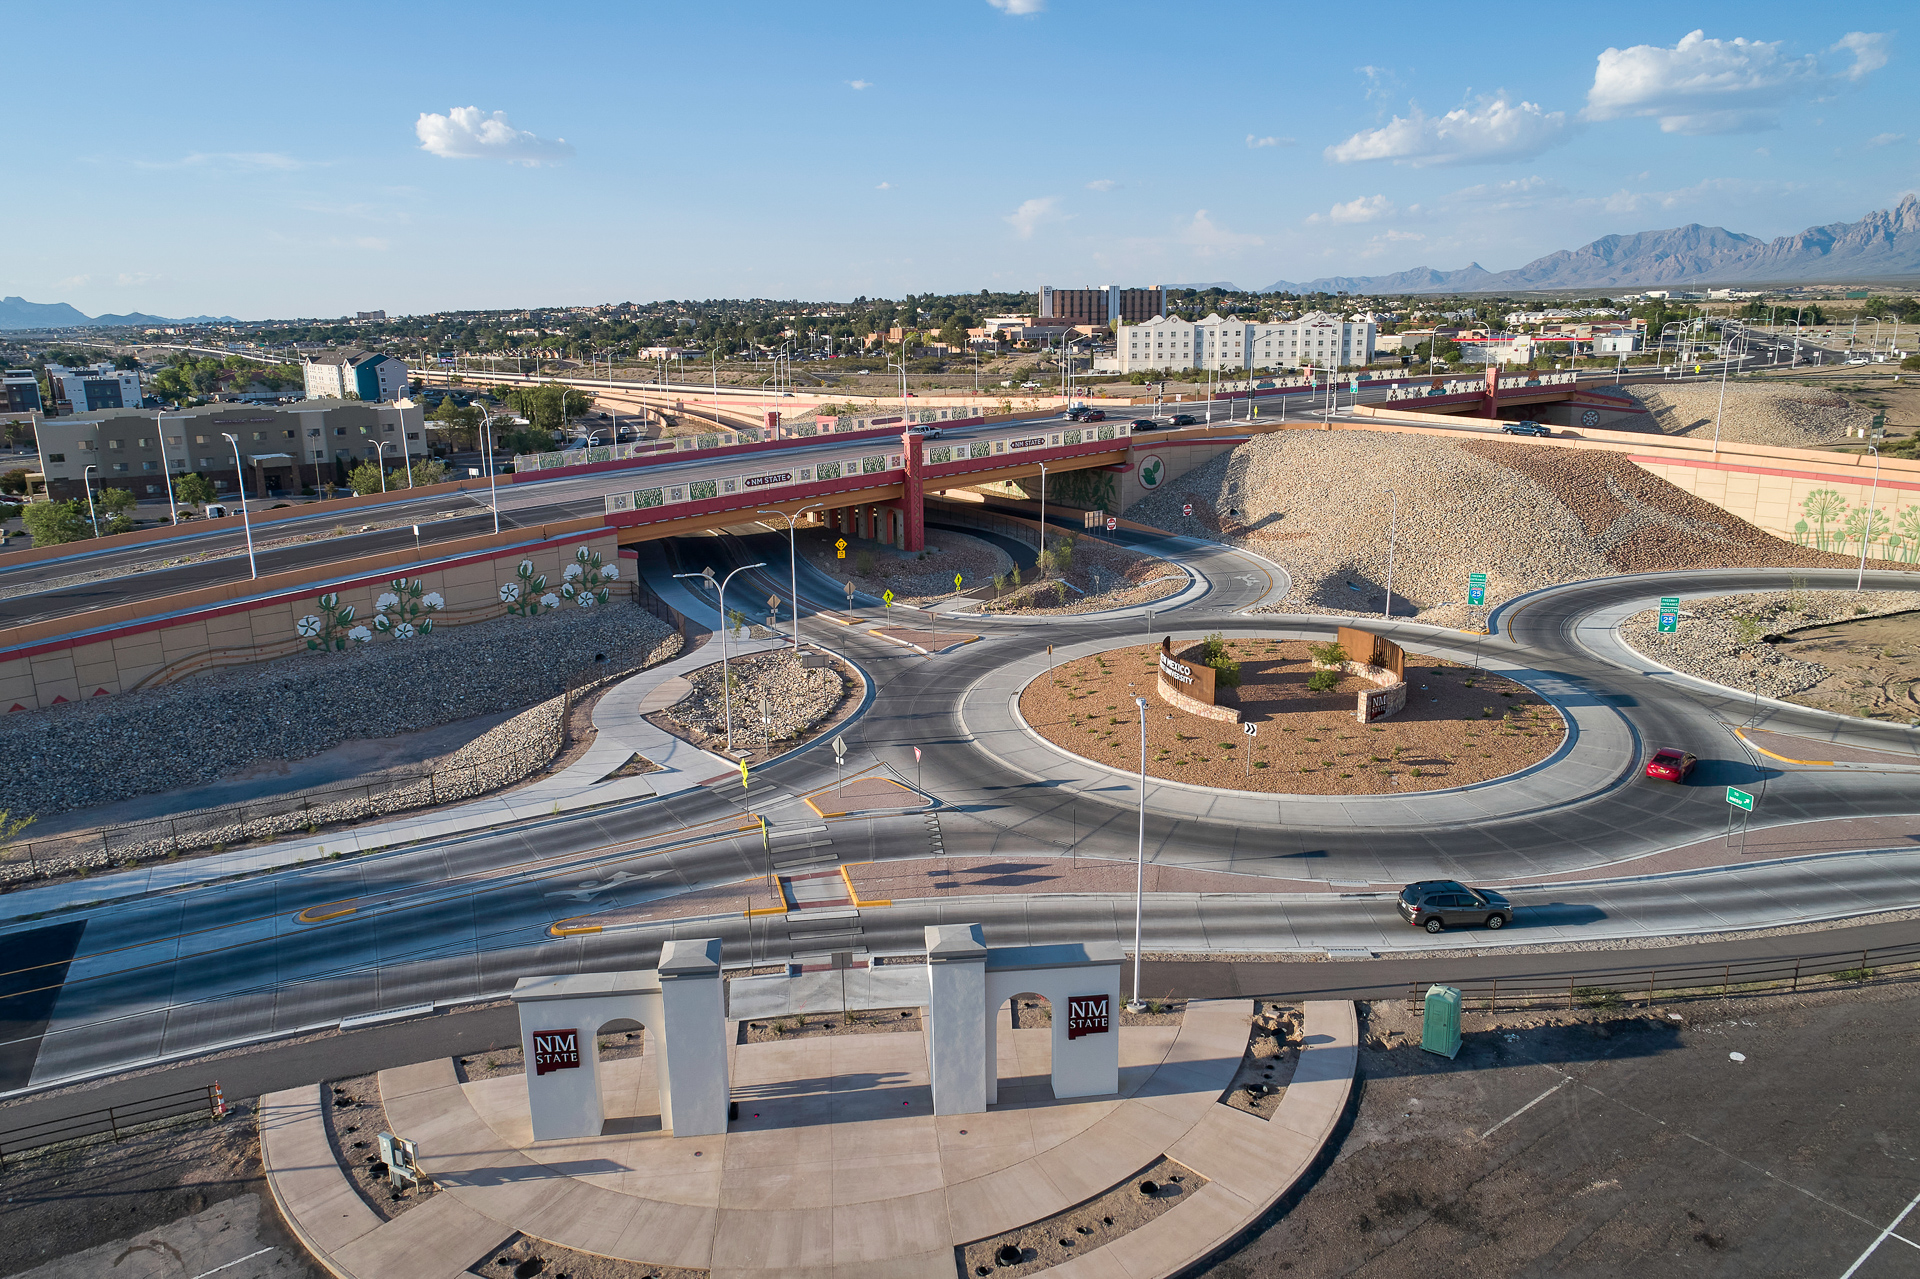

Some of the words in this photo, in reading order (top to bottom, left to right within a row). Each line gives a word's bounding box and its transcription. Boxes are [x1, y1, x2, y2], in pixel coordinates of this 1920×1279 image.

[1024, 438, 1041, 446] STATE
[751, 478, 763, 486] NM
[764, 474, 786, 484] STATE
[1167, 657, 1190, 676] MEXICO
[1372, 694, 1386, 706] NM
[1070, 1000, 1108, 1018] NM
[1070, 1018, 1108, 1029] STATE
[535, 1034, 577, 1053] NM
[536, 1052, 578, 1064] STATE
